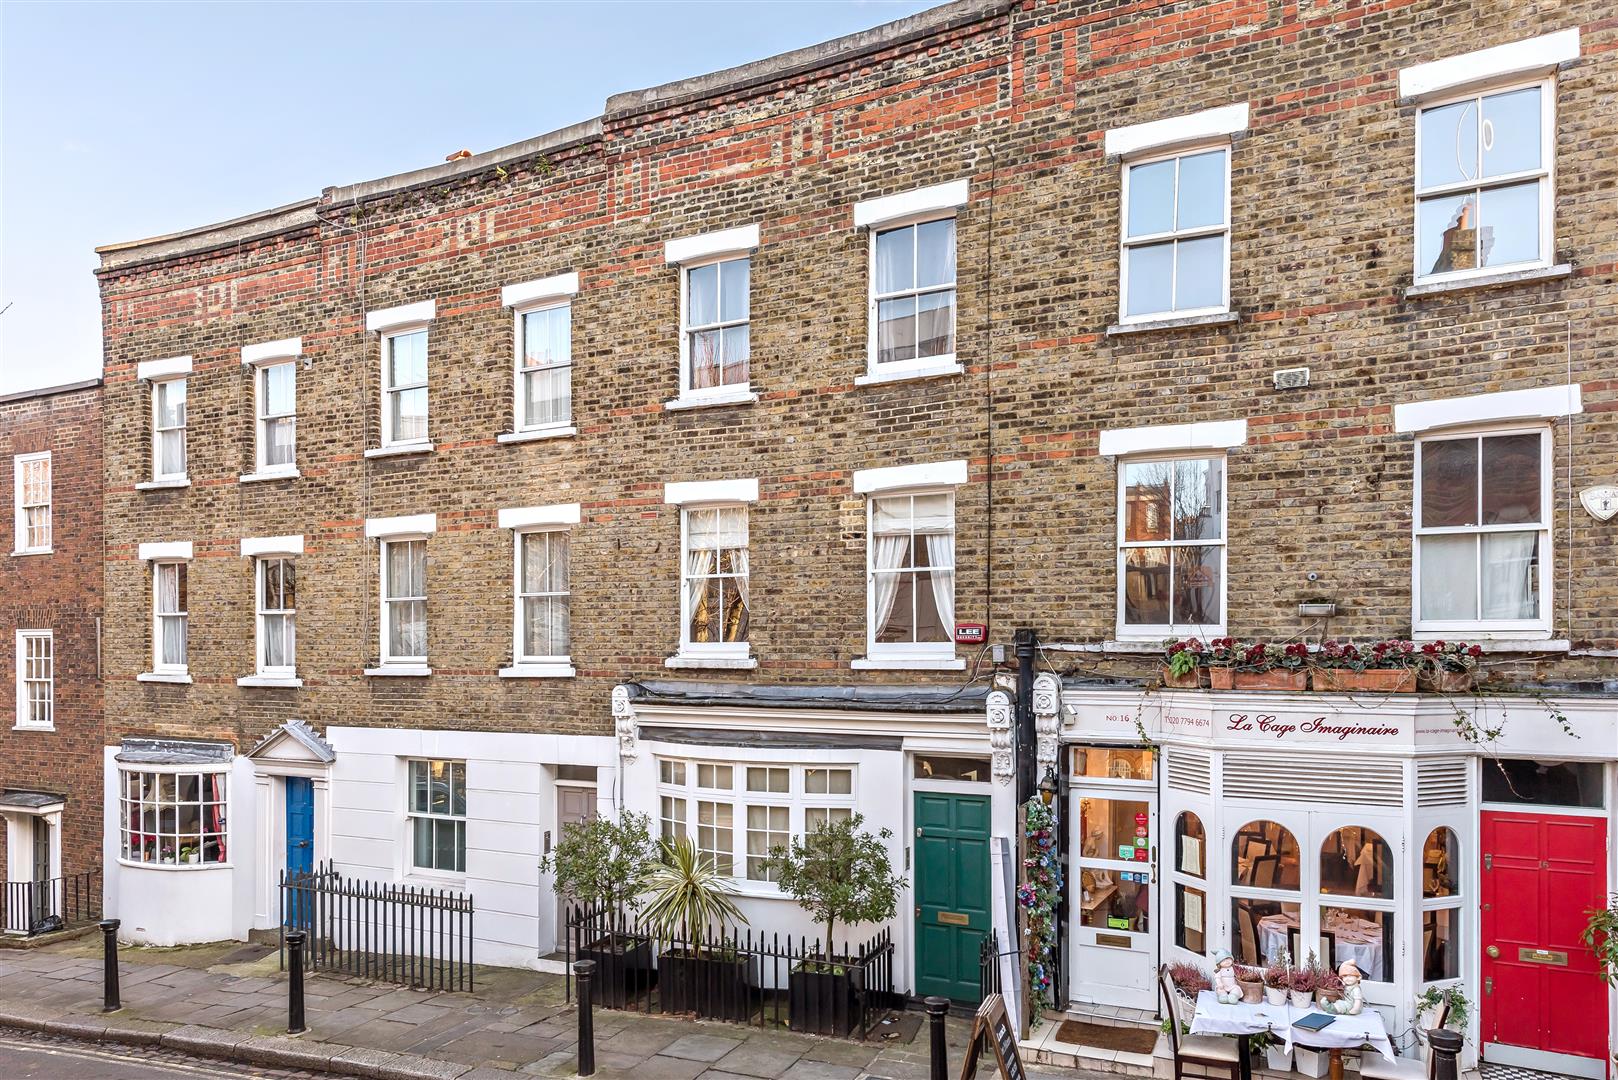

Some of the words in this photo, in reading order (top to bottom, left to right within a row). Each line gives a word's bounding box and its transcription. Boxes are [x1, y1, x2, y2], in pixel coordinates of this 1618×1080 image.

[1120, 714, 1130, 722] 16
[1181, 717, 1195, 725] 7794
[1196, 719, 1210, 727] 6674
[1227, 714, 1253, 731] La
[1256, 714, 1296, 738] Cage
[1300, 717, 1399, 740] Imaginaire
